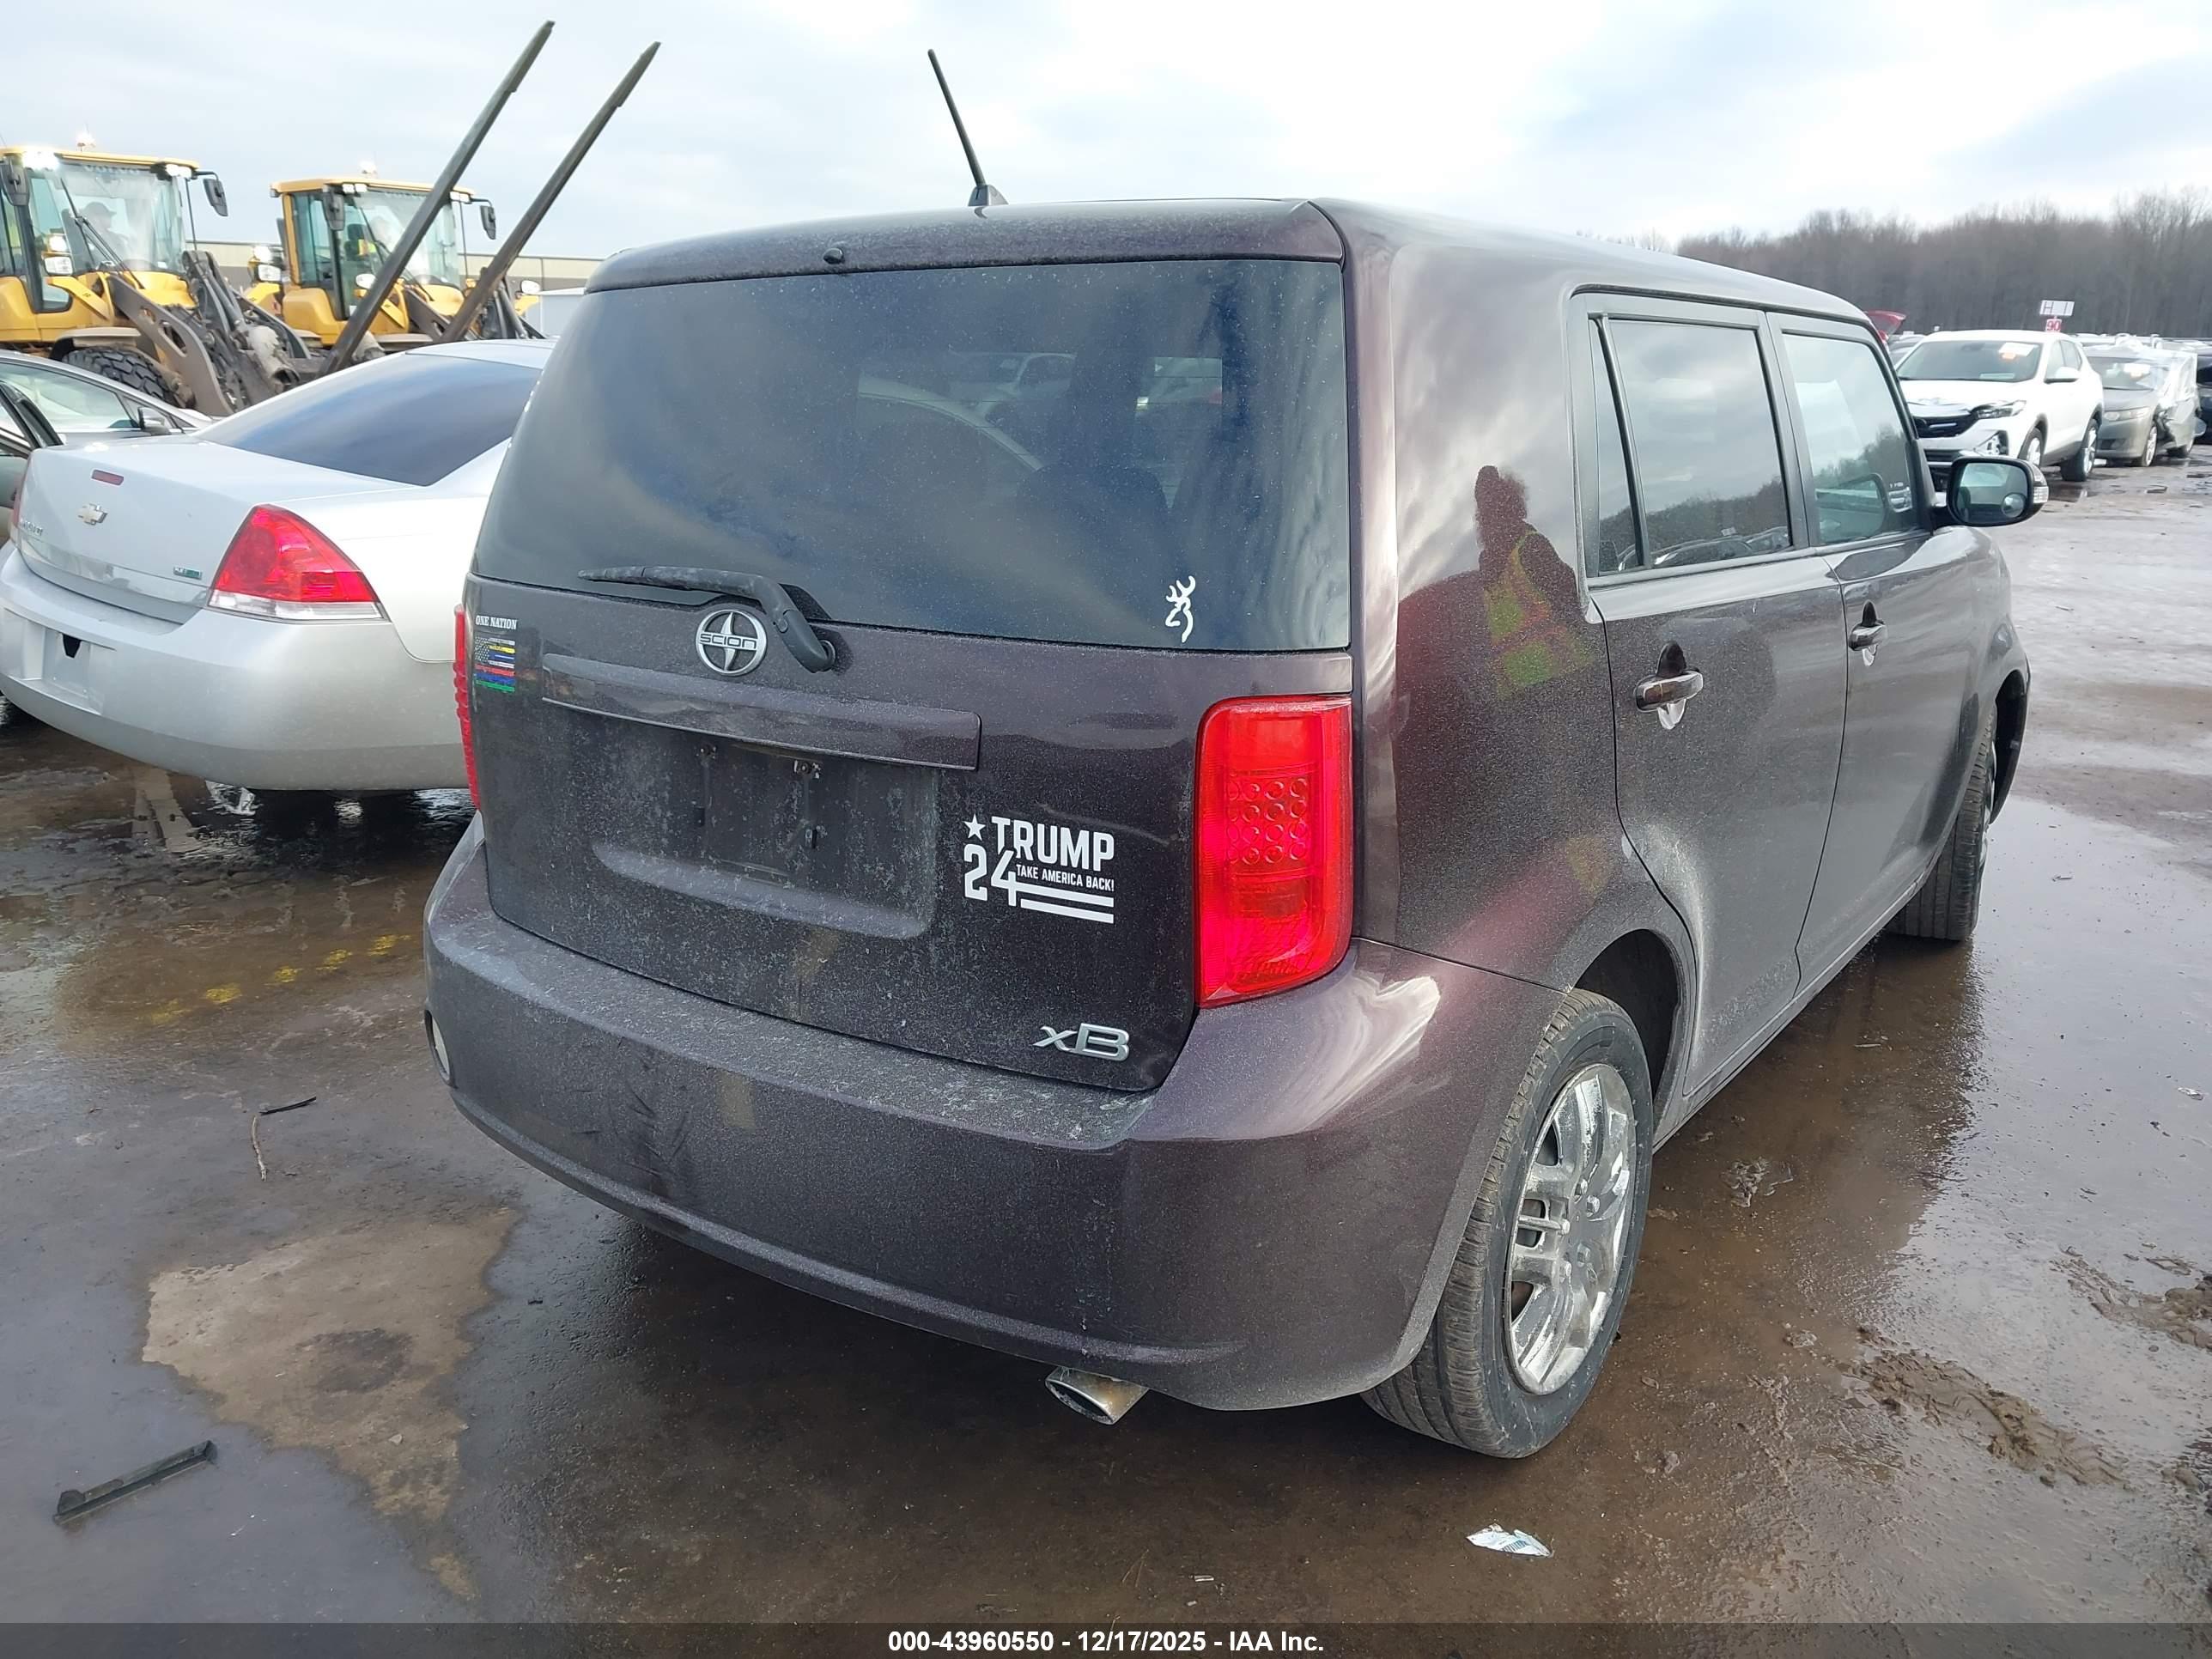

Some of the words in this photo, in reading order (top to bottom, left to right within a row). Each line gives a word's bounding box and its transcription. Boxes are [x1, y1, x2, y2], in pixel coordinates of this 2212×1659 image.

[476, 615, 489, 626] ONE
[490, 617, 517, 629] NATION
[700, 634, 757, 649] SCION
[991, 816, 1115, 872] TRUMP
[963, 843, 1017, 907] 24
[1016, 864, 1039, 879] TAKE
[1042, 868, 1084, 887] AMERICA
[1085, 876, 1115, 892] BACK!
[1032, 1023, 1129, 1061] xB
